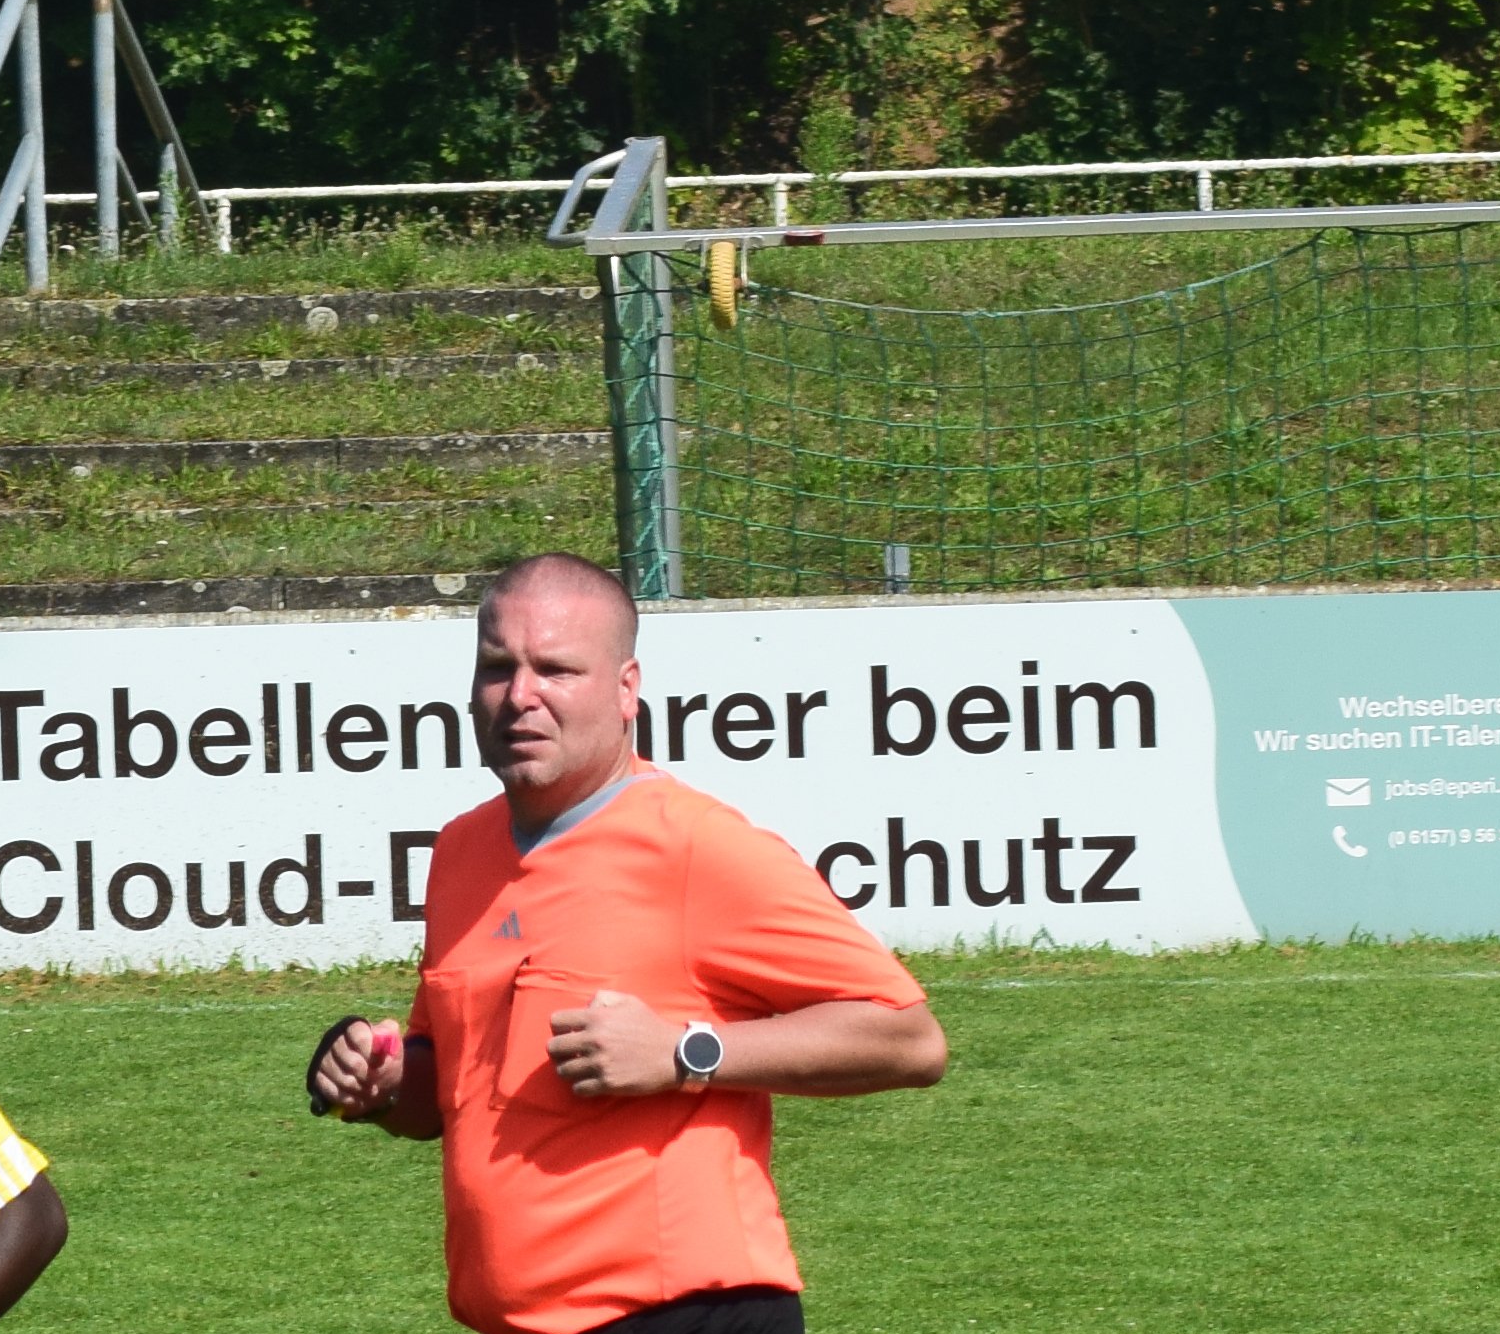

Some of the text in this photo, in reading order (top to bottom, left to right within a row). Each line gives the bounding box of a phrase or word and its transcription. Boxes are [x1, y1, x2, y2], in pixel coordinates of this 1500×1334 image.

[870, 660, 1157, 756] beim
[1254, 730, 1299, 752] Wir
[1305, 728, 1402, 751] suchen
[1409, 828, 1456, 847] 6157)
[1459, 828, 1472, 843] 9
